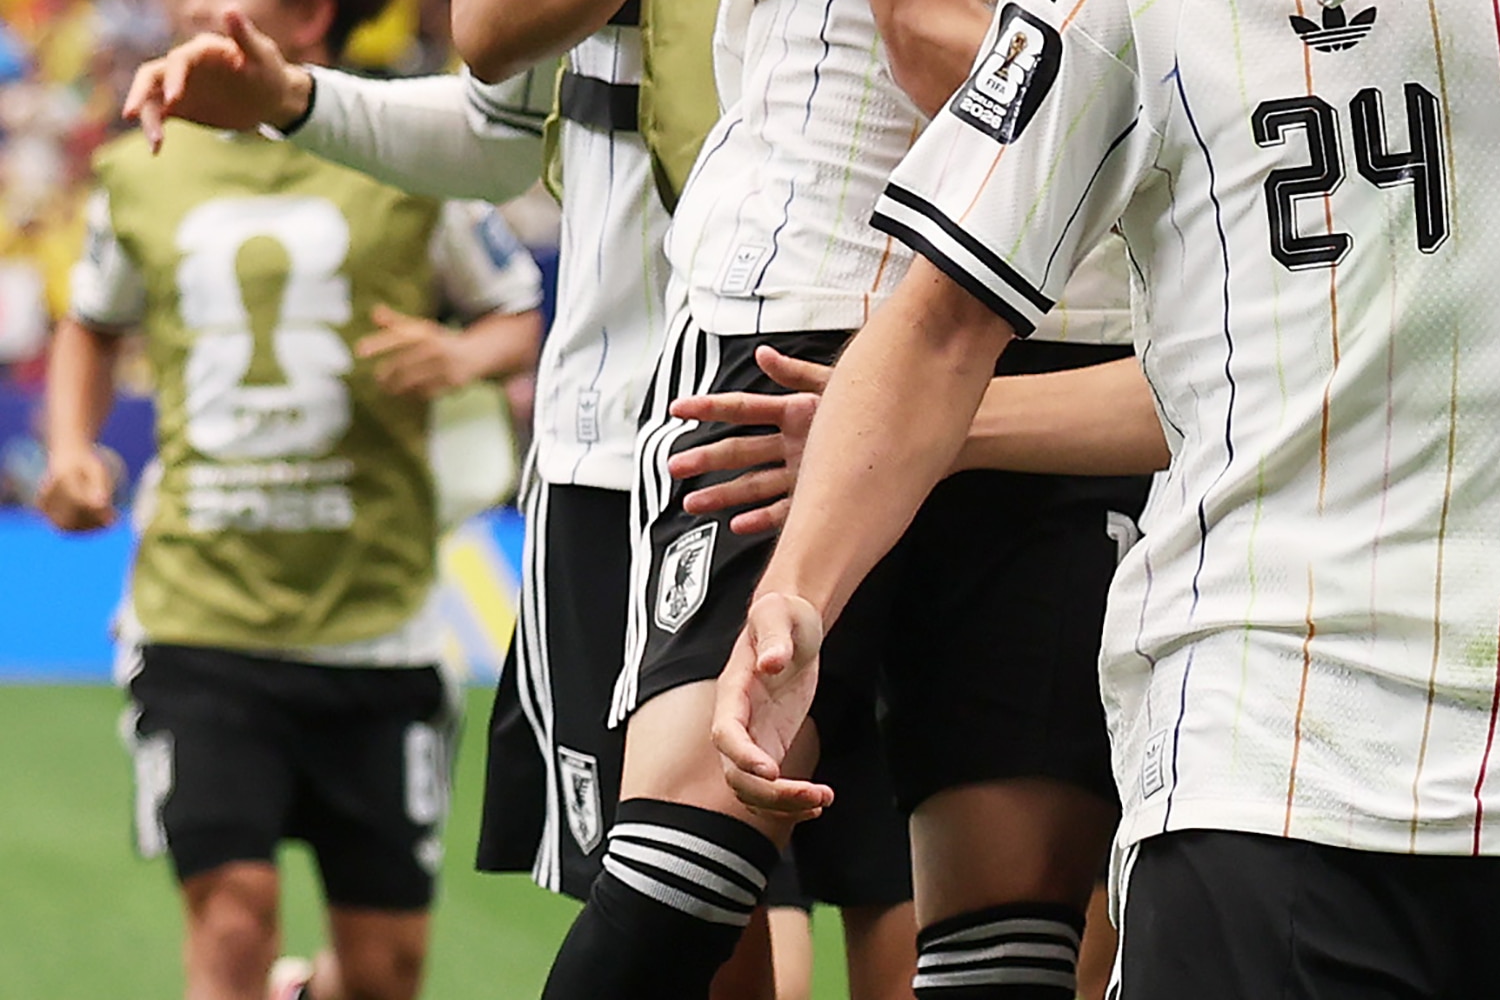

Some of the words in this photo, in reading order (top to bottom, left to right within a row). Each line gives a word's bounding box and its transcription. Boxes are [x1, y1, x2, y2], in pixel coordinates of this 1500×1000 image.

[986, 78, 1006, 95] FIFA
[960, 97, 1003, 130] 2026
[1251, 83, 1450, 272] 24
